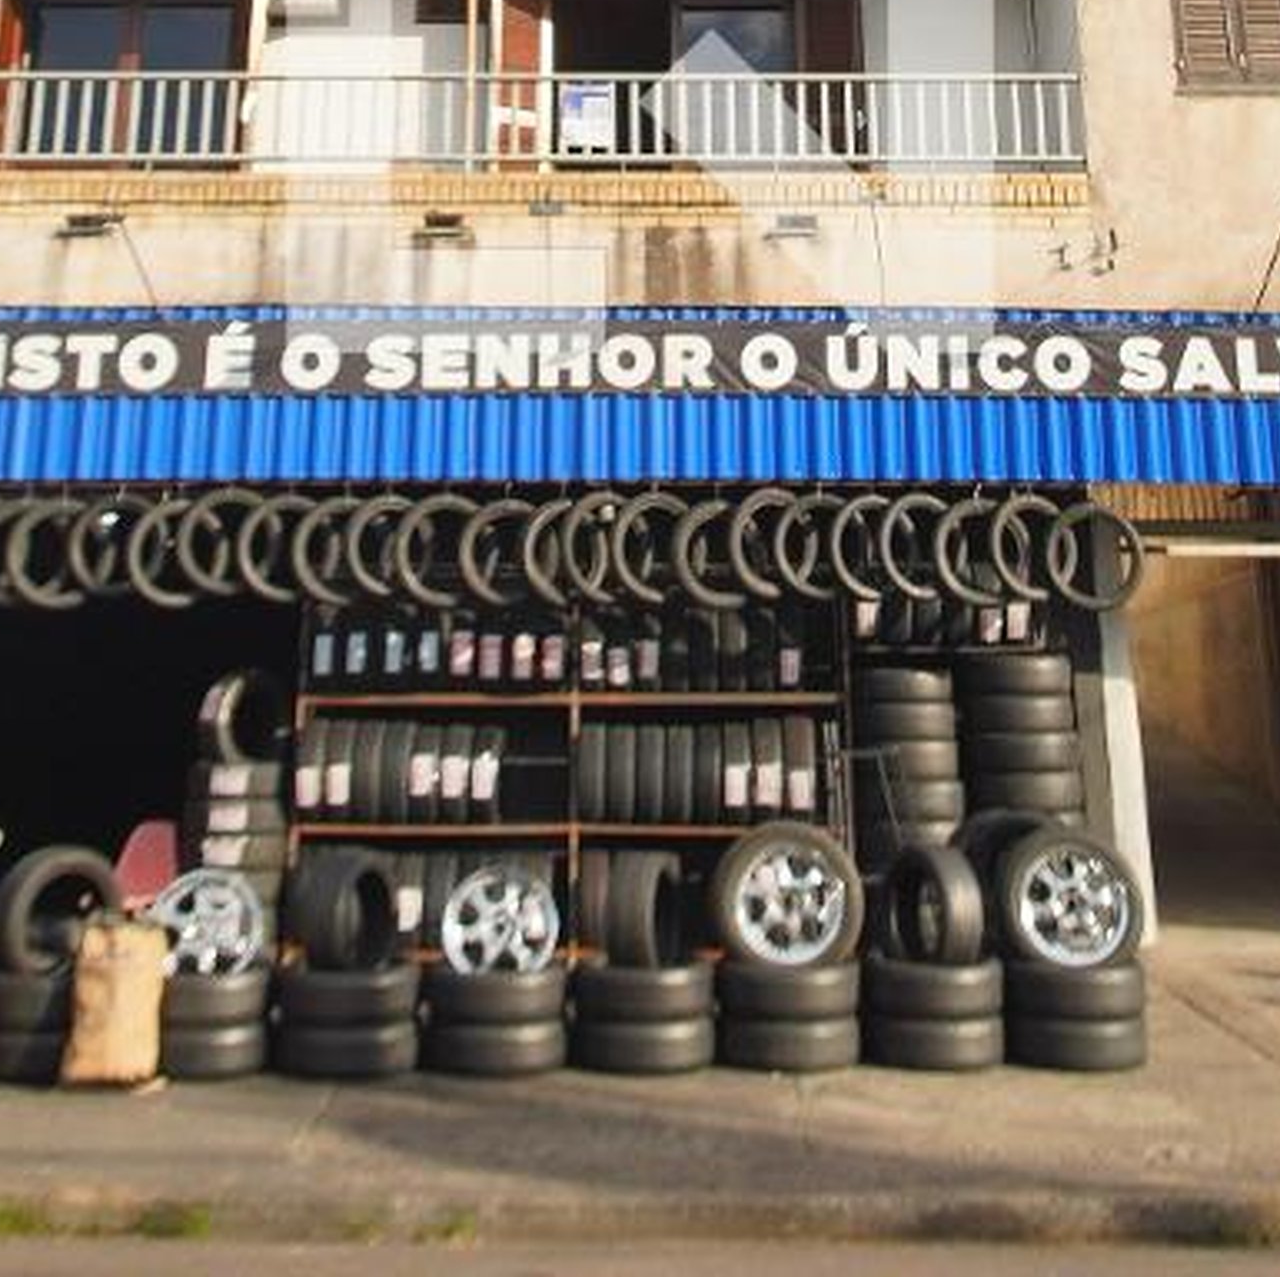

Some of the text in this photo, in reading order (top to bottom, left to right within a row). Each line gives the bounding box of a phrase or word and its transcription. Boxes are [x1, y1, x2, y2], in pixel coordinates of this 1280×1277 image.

[204, 321, 257, 391] É
[281, 334, 341, 391] O
[364, 333, 715, 392] SENHOR
[740, 334, 797, 391] O
[826, 323, 1092, 392] ÚNICO
